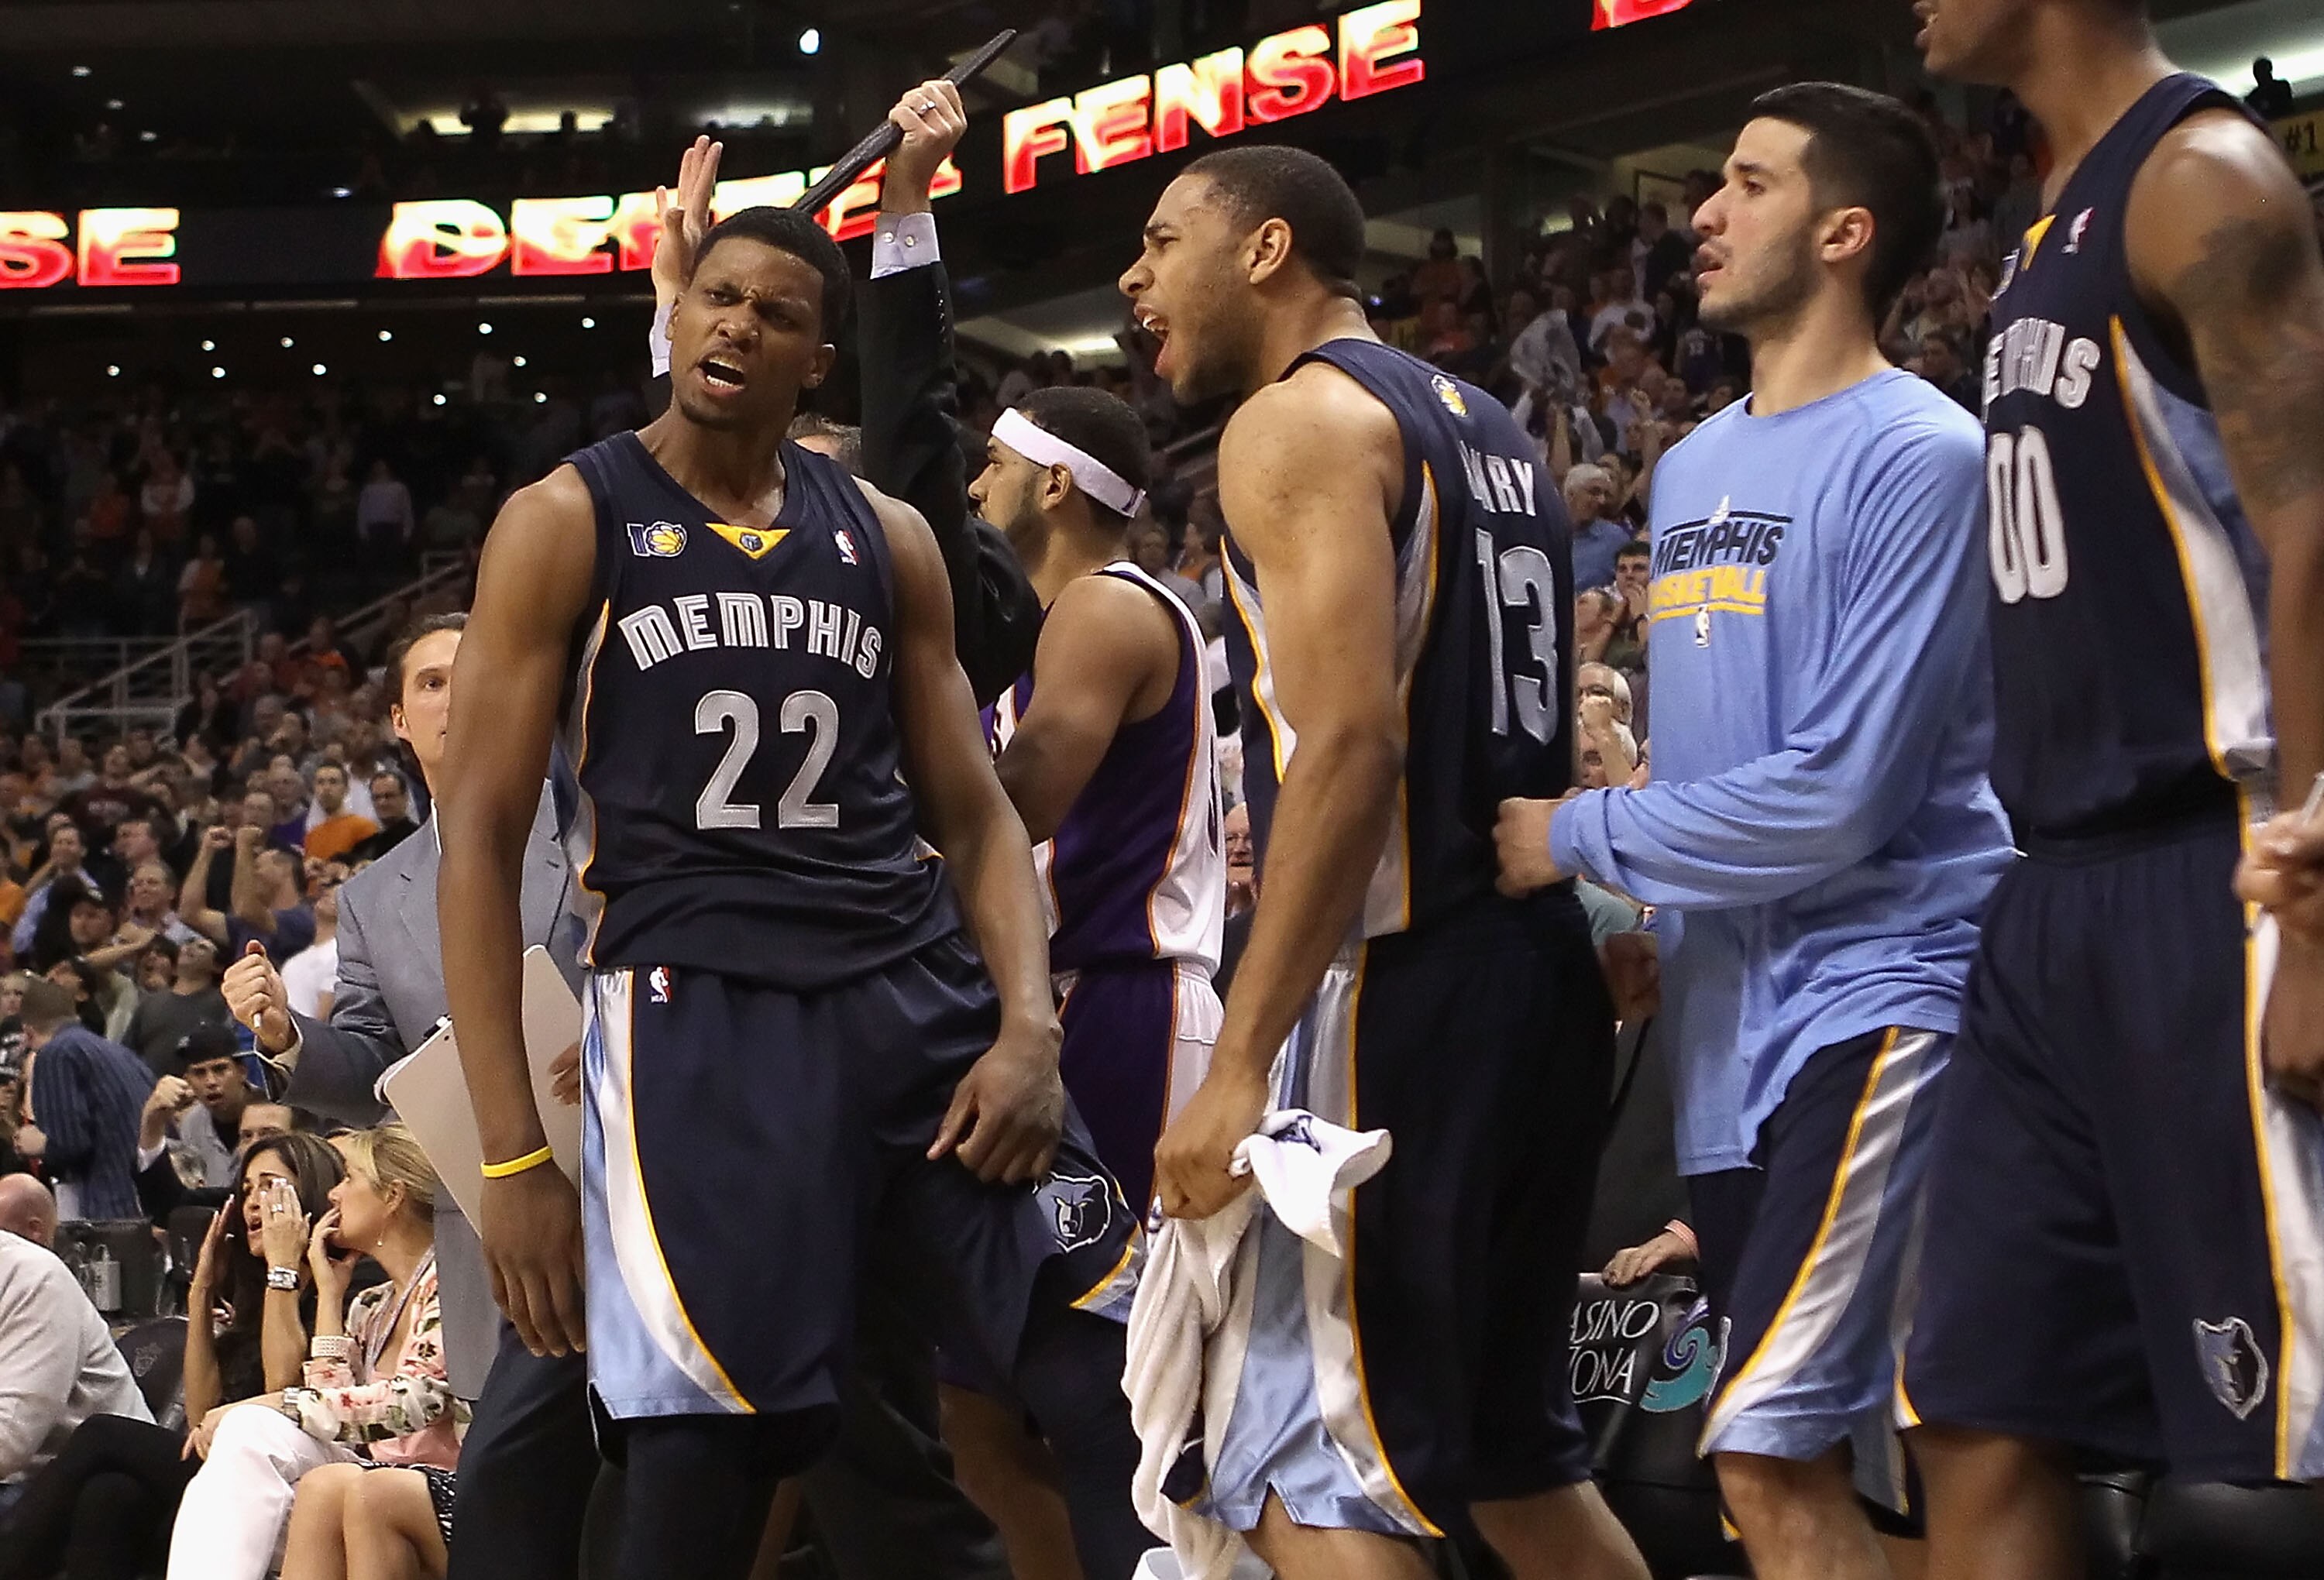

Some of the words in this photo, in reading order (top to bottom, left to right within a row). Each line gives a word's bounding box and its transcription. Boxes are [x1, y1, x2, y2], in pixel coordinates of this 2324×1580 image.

[1002, 0, 1426, 194] FENSE
[2285, 120, 2318, 153] #1
[1651, 521, 1785, 579] MEMPHIS
[1987, 424, 2068, 604] 00
[617, 592, 882, 679] MEMPHIS
[1474, 527, 1559, 747] 13
[694, 689, 840, 830] 22
[1569, 1300, 1660, 1344] ASINO
